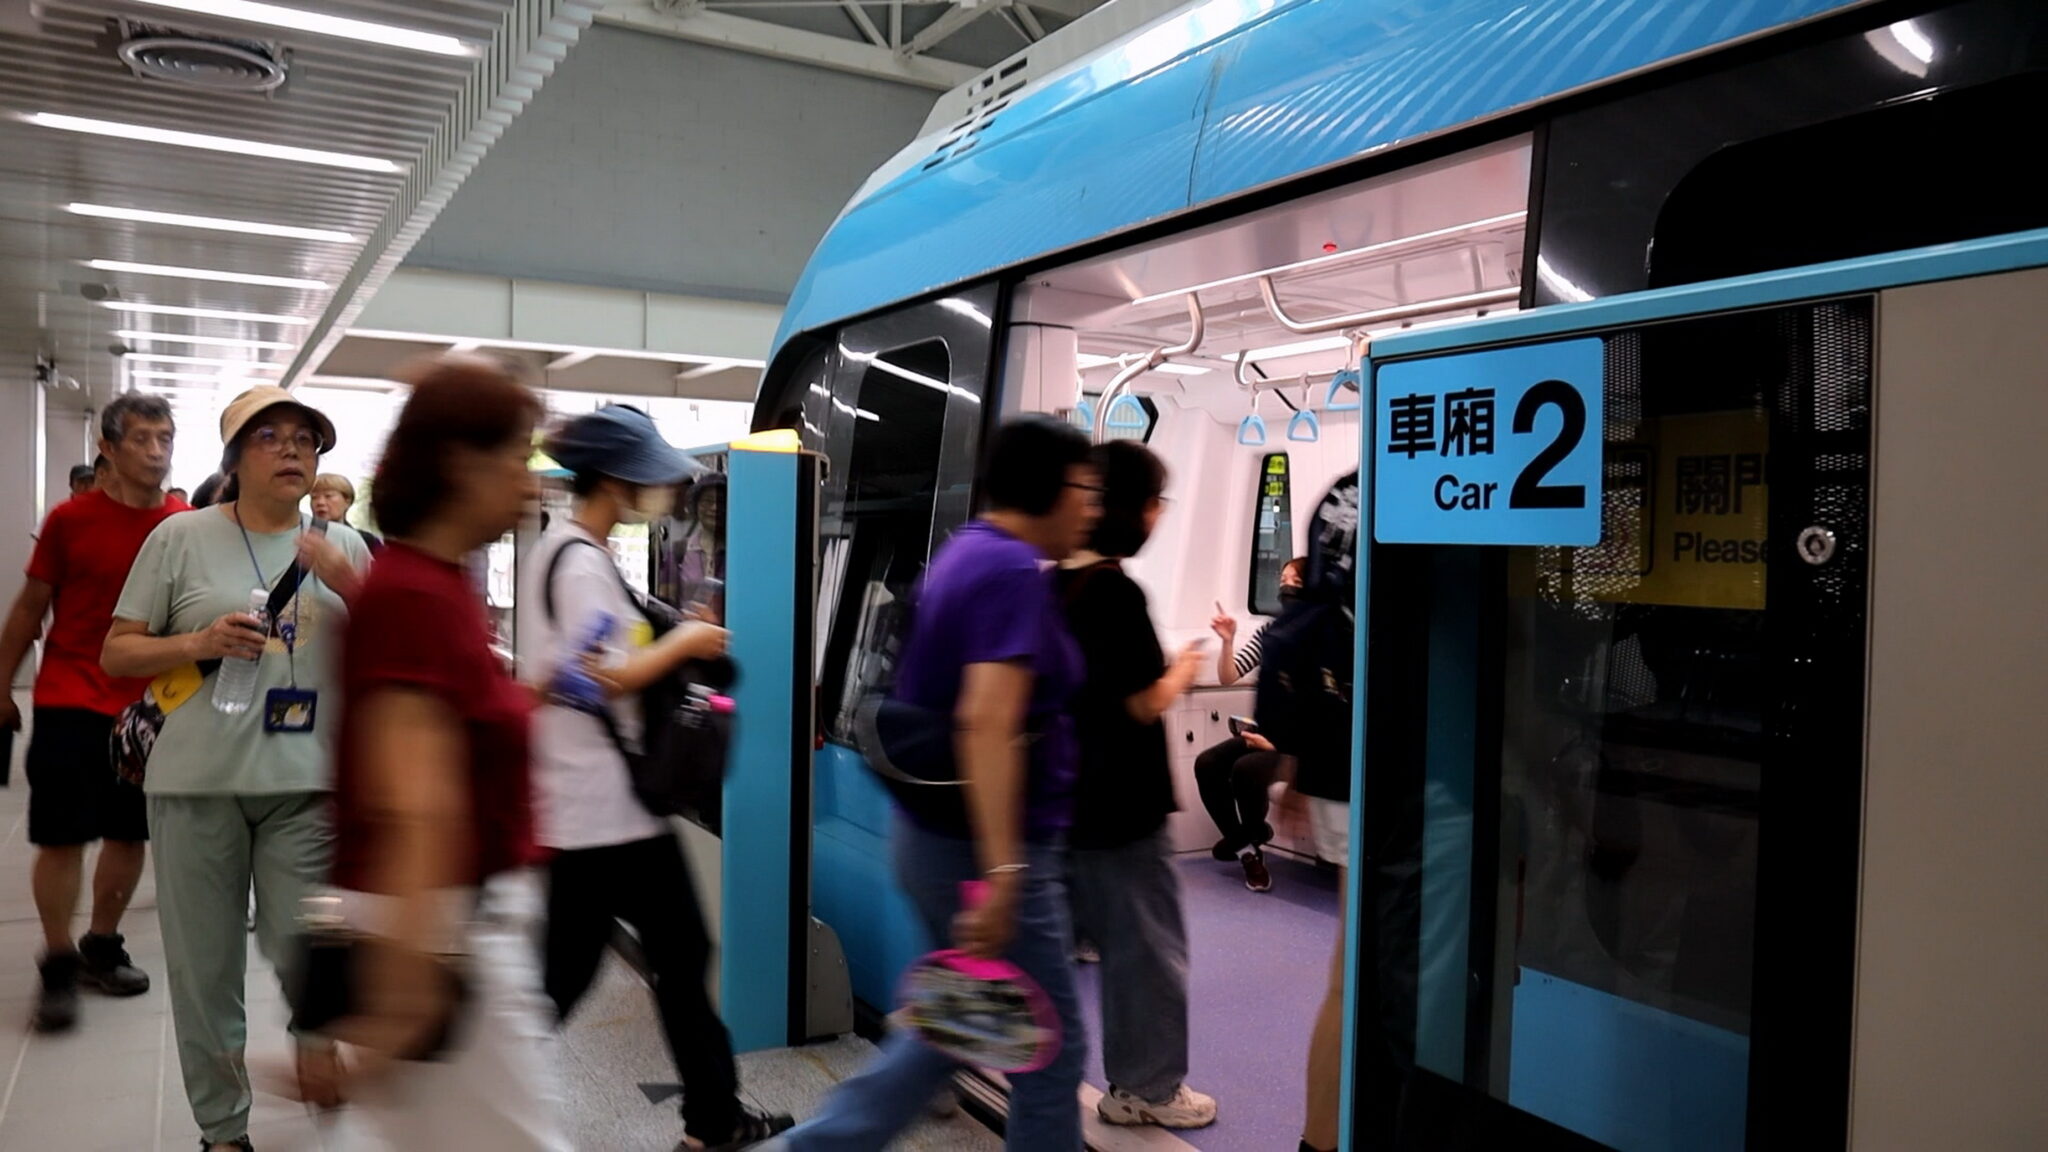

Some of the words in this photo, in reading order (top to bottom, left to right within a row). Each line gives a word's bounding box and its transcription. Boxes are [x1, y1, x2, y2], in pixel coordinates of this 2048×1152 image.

[1387, 386, 1496, 460] 車廂
[1508, 379, 1587, 510] 2
[1434, 474, 1498, 511] Car
